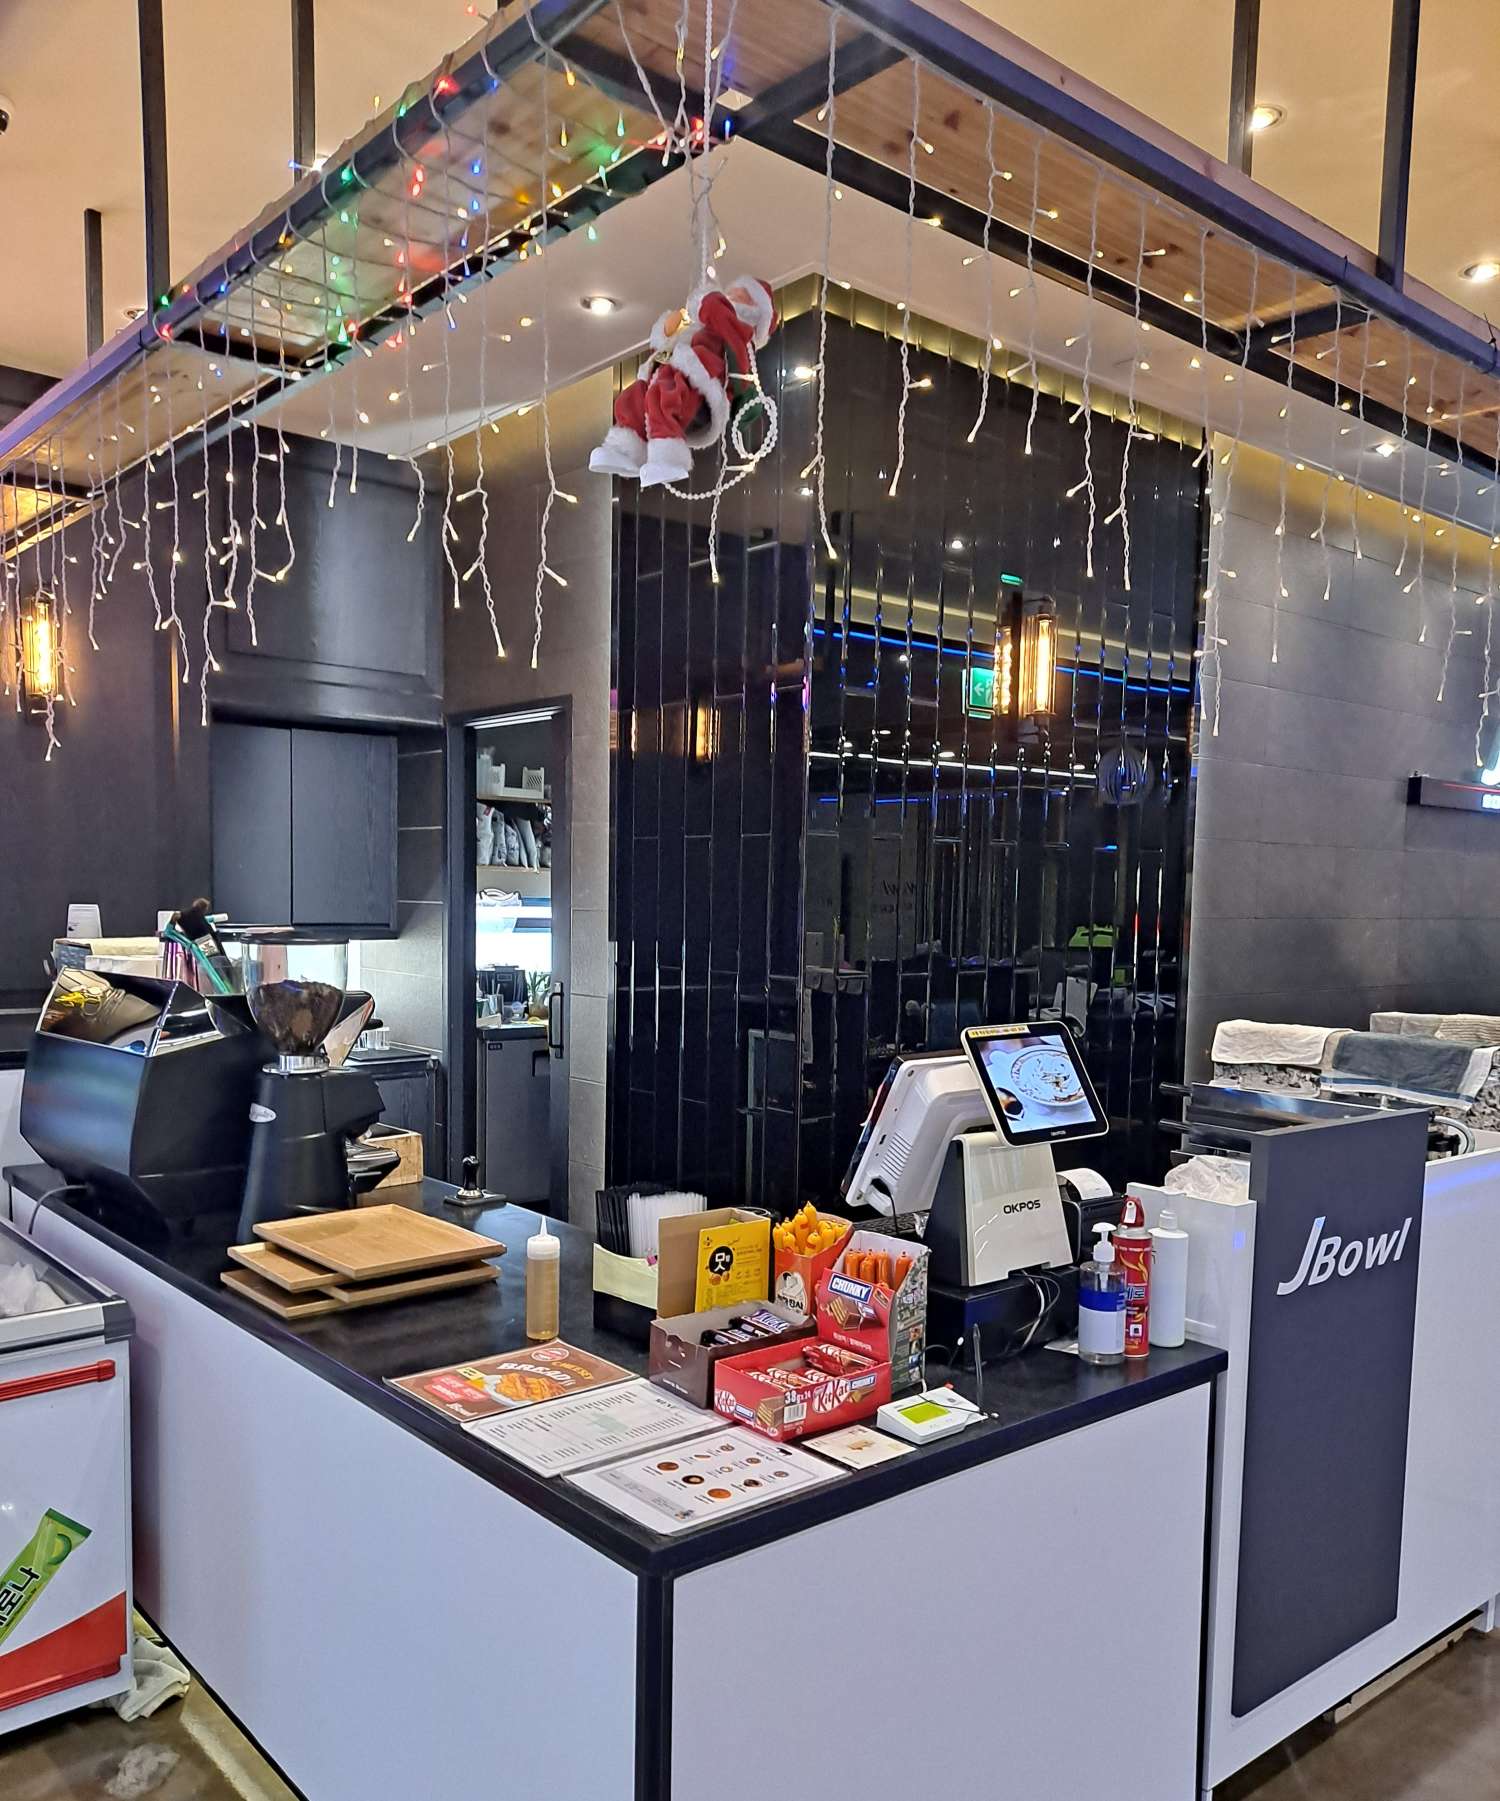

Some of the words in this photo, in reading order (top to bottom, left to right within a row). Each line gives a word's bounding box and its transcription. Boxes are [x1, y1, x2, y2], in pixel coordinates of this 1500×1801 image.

[1003, 1199, 1041, 1214] OKPOS
[1276, 1216, 1413, 1296] JBowl
[831, 1277, 871, 1299] CHUNKY
[496, 1362, 571, 1381] BREAD
[817, 1379, 850, 1413] KitKat
